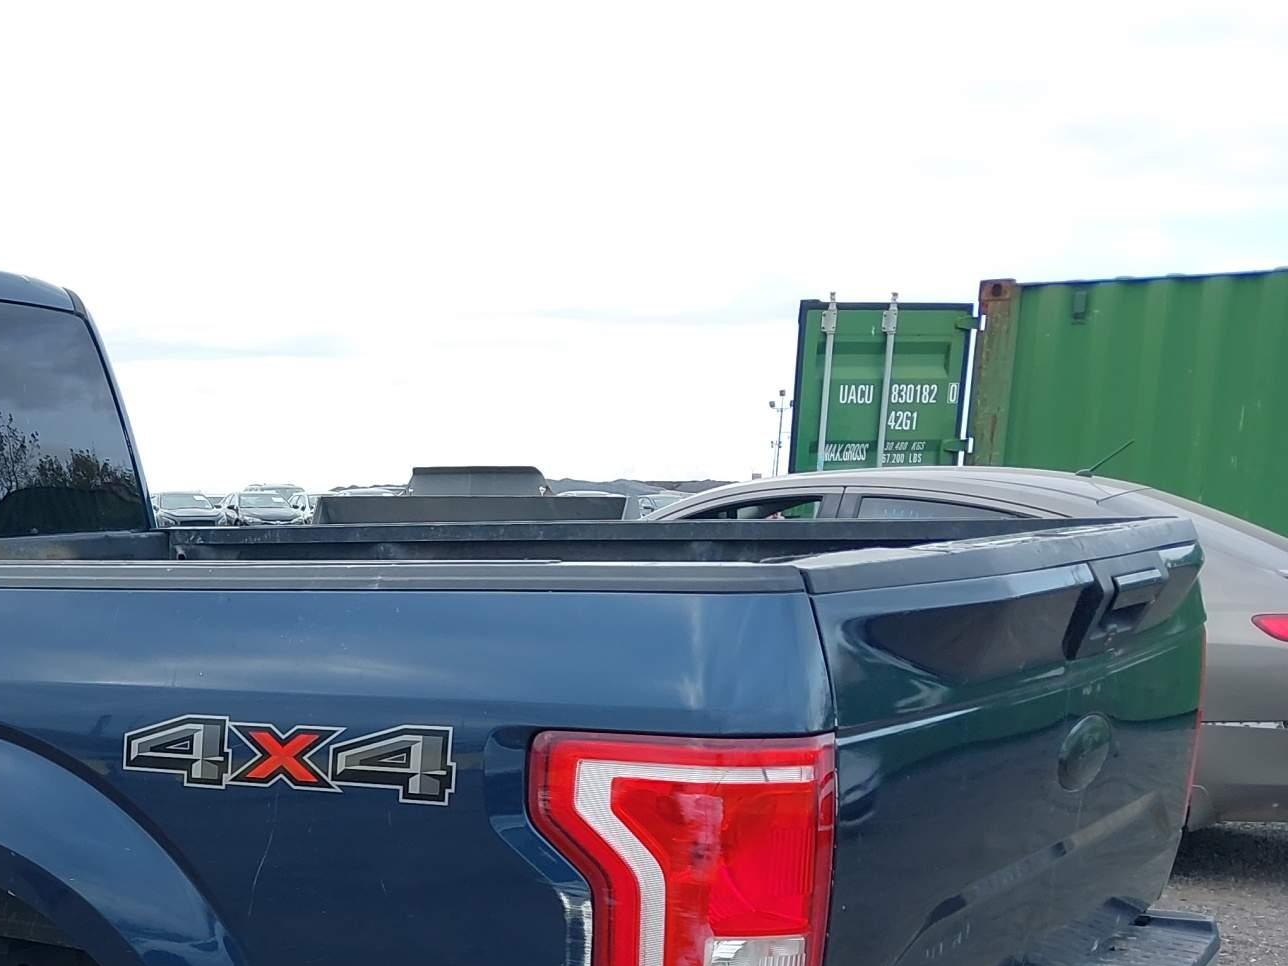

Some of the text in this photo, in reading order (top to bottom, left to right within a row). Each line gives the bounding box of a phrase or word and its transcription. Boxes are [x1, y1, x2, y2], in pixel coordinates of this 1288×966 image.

[839, 384, 874, 404] UACU
[891, 383, 938, 404] 830182
[887, 410, 918, 431] 42G1
